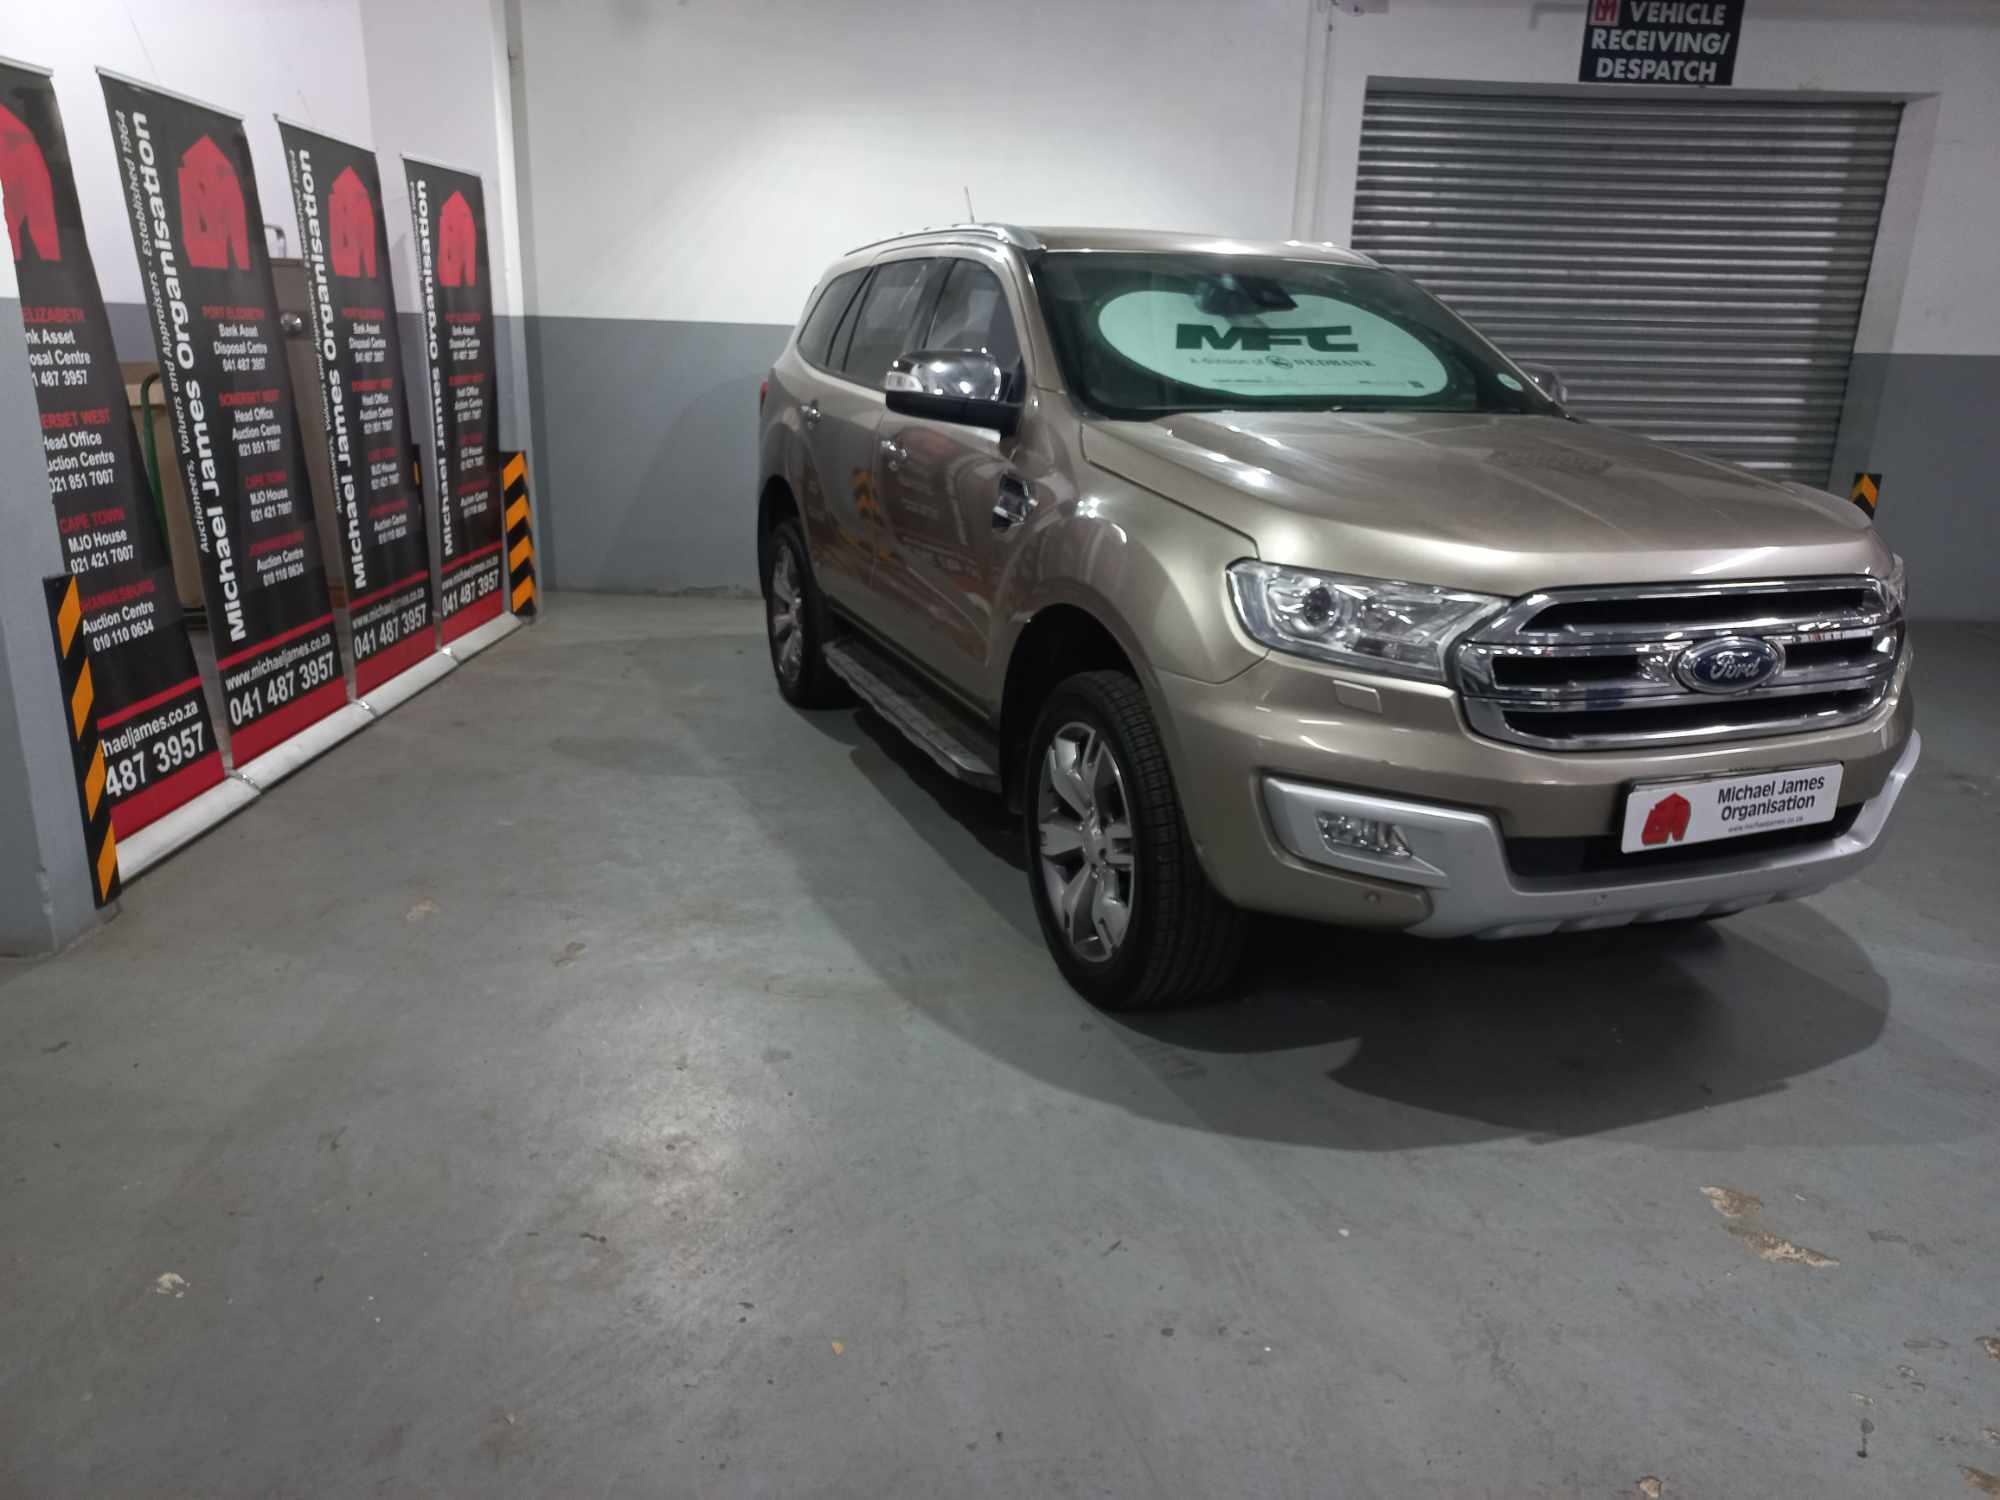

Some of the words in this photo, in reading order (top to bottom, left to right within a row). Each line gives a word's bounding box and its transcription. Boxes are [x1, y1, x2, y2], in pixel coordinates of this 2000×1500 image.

[1629, 0, 1727, 26] VEHICLE
[1591, 28, 1731, 55] RECEIVING/
[1595, 58, 1717, 82] DESPATCH
[114, 109, 133, 154] 1964
[124, 157, 152, 257] Established
[133, 111, 194, 369] Organisation
[299, 149, 337, 361] Organisation
[416, 179, 438, 360] Organisation
[149, 271, 173, 358] Appraisers
[43, 329, 76, 345] Asset
[1176, 322, 1359, 353] MFC
[54, 350, 91, 365] Centre
[41, 370, 60, 386] 487
[62, 370, 88, 386] 3957
[164, 359, 180, 393] and
[174, 396, 191, 454] Valuers
[253, 406, 274, 421] Office
[329, 369, 351, 468] James
[432, 367, 445, 451] James
[69, 431, 102, 448] Office
[185, 379, 220, 497] James
[80, 451, 115, 468] Centre
[68, 473, 88, 490] 851
[89, 468, 114, 486] 7007
[187, 459, 210, 553] Auctioneers,
[438, 457, 453, 556] Michael
[68, 535, 92, 553] MJO
[92, 529, 128, 548] House
[340, 474, 367, 590] Michael
[70, 557, 90, 574] 021
[91, 550, 110, 569] 421
[110, 544, 134, 563] 7007
[207, 506, 247, 642] Michael
[442, 590, 459, 617] 041
[460, 581, 477, 605] 487
[477, 568, 499, 598] 3957
[82, 612, 121, 636] Auction
[121, 600, 155, 622] Centre
[93, 635, 112, 653] 010
[112, 626, 131, 644] 110
[130, 618, 155, 639] 0634
[353, 628, 376, 660] 041
[379, 616, 400, 646] 487
[401, 602, 427, 634] 3957
[1711, 651, 1759, 680] Ford
[229, 687, 262, 726] 041
[267, 669, 294, 705] 487
[298, 651, 333, 689] 3957
[106, 751, 147, 797] 487
[152, 721, 204, 772] 3957
[1717, 781, 1776, 804] Michael
[1777, 775, 1826, 792] James
[1719, 795, 1815, 822] Organisation
